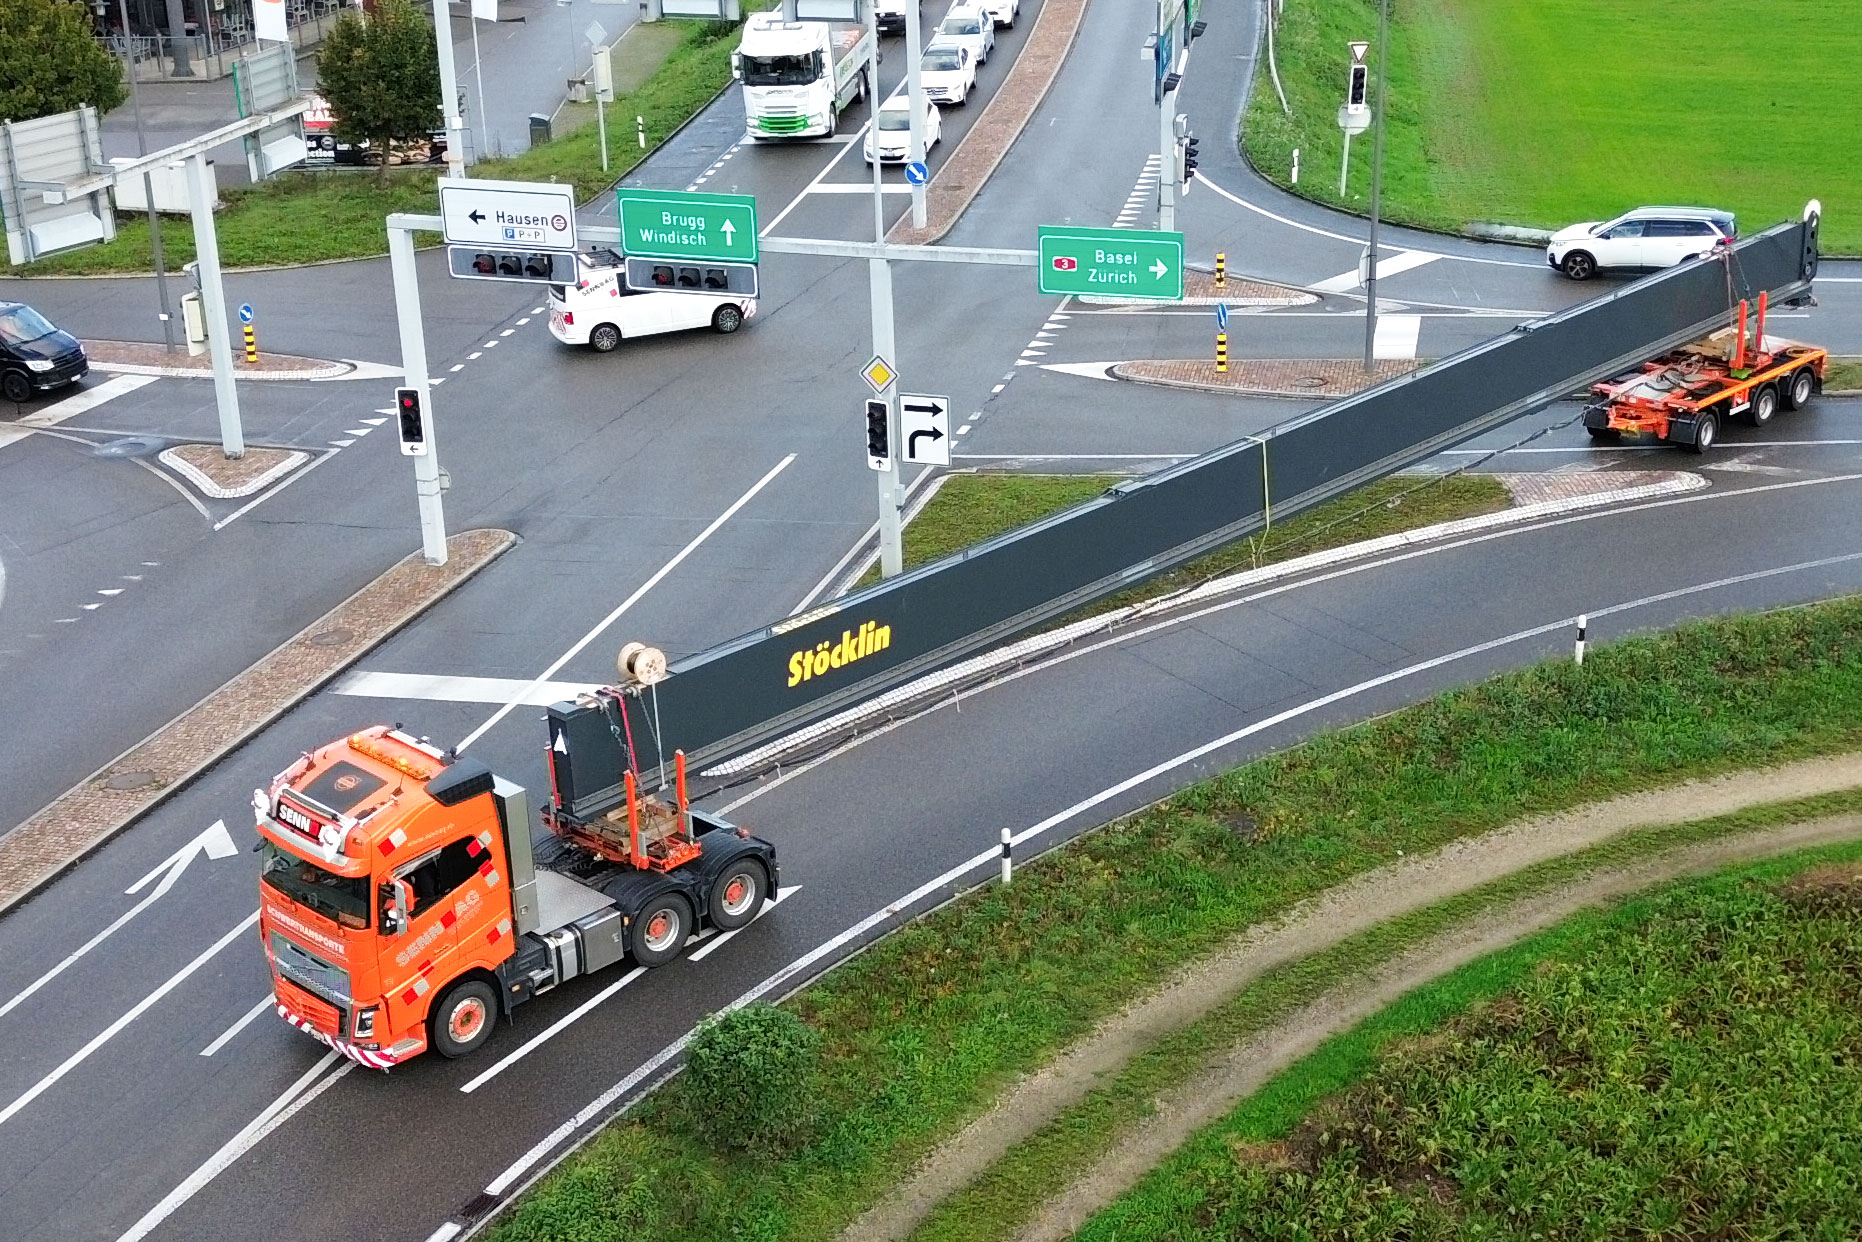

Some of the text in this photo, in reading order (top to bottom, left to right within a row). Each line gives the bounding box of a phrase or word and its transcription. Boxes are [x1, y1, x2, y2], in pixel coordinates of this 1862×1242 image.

[496, 211, 548, 226] Hausen
[662, 212, 705, 230] Brugg
[640, 229, 706, 245] Windisch
[1061, 259, 1068, 269] 3
[1095, 249, 1137, 265] Basel
[1088, 269, 1137, 284] Zürich
[788, 621, 891, 687] Stöcklin
[279, 805, 311, 833] SENN
